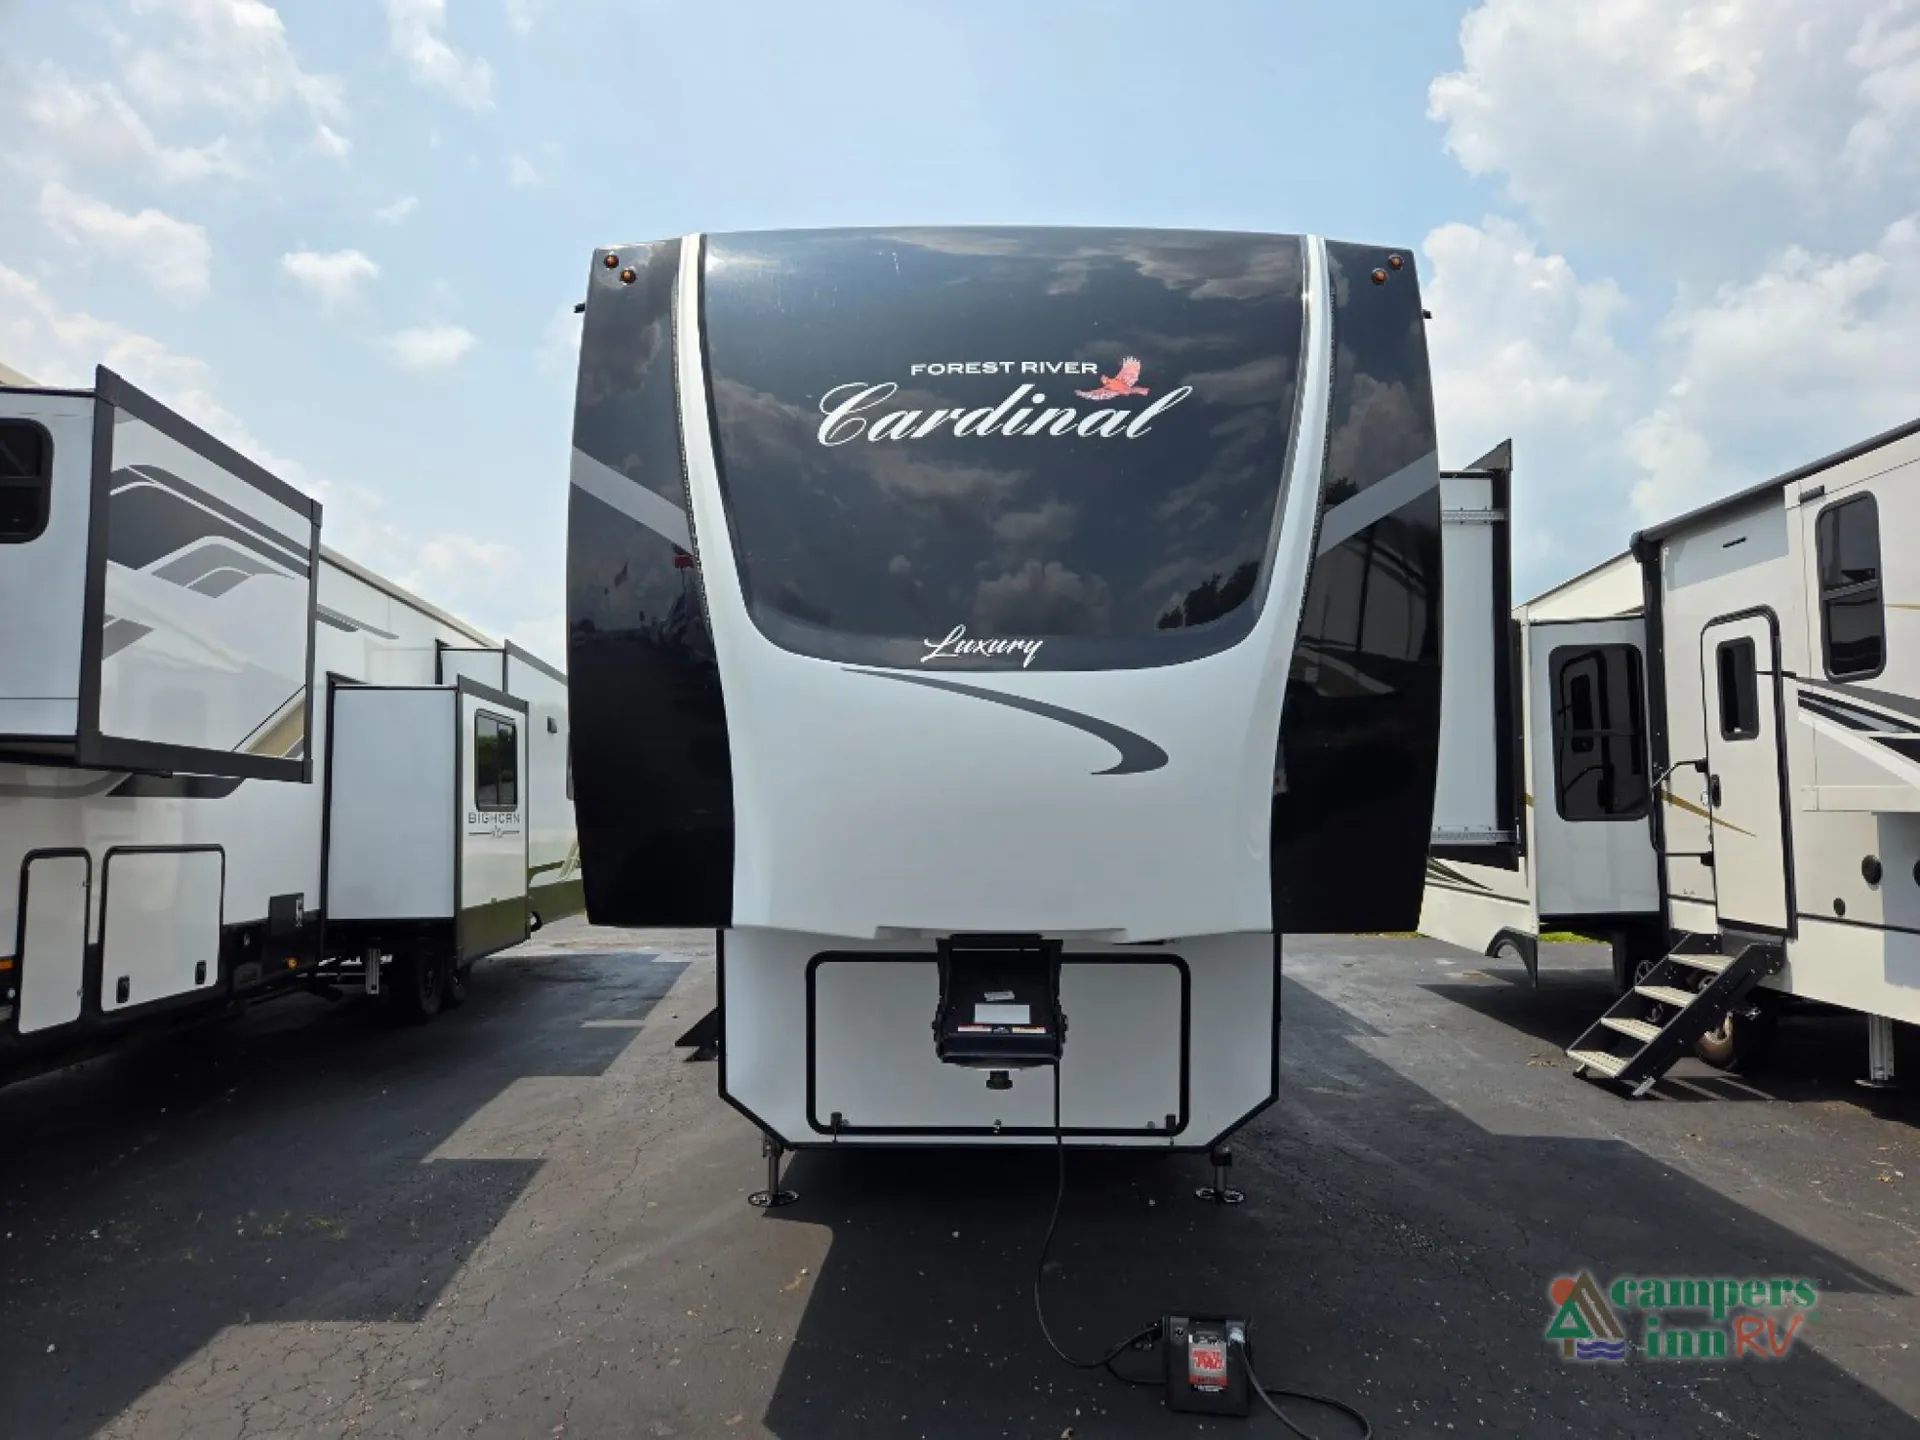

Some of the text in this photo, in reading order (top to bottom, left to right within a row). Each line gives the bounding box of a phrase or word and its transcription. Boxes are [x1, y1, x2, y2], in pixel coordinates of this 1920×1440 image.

[910, 361, 1098, 376] FOREST RIVER
[816, 382, 1193, 447] Cardinal
[920, 624, 1044, 668] Luxury
